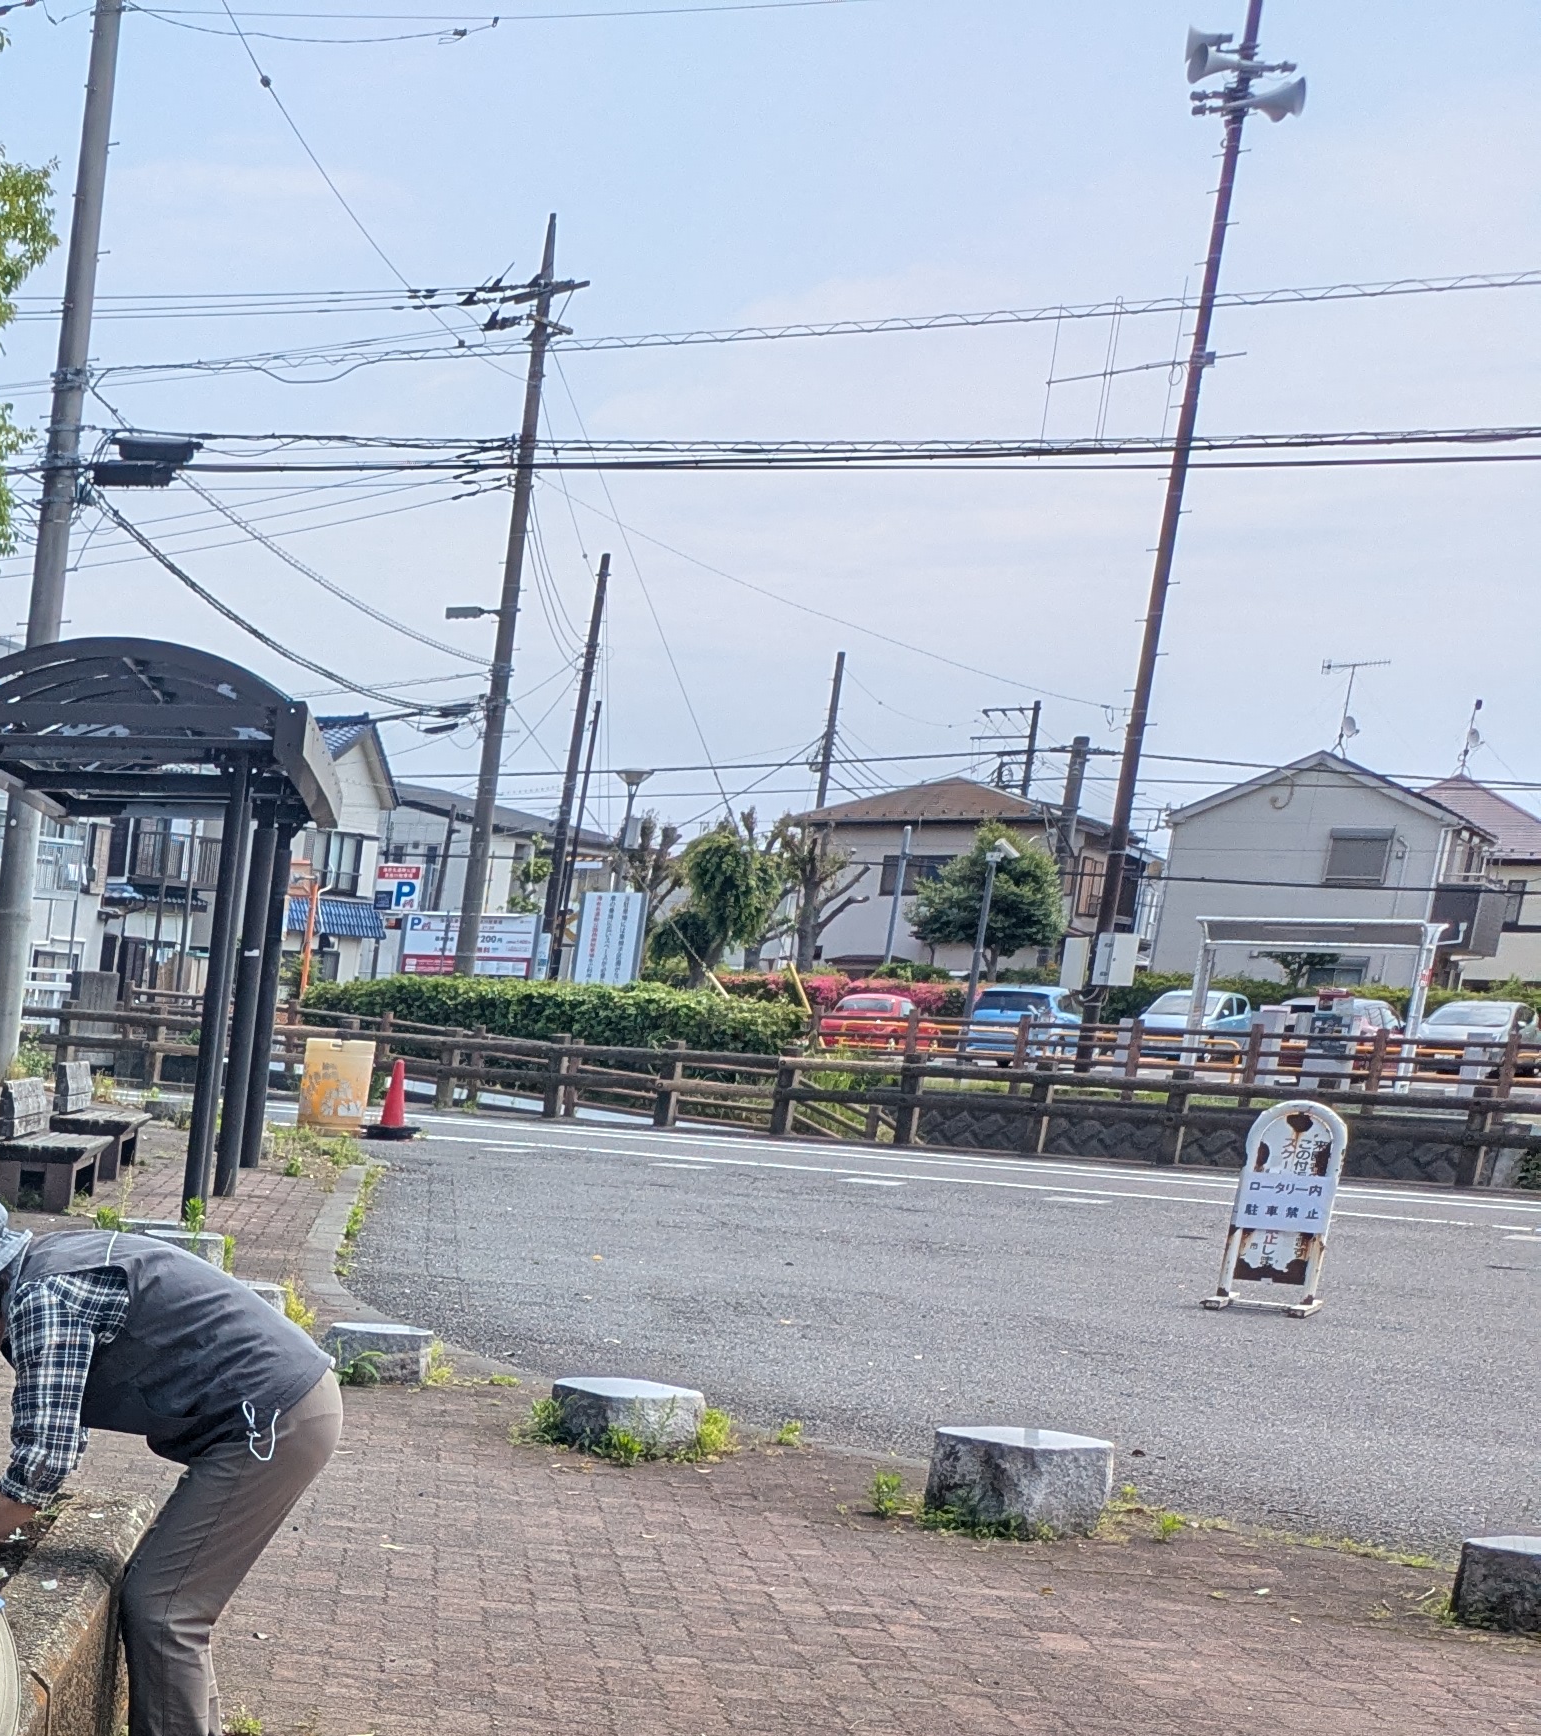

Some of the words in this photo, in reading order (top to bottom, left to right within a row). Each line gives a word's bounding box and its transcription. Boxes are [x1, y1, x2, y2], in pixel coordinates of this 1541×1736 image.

[394, 881, 416, 907] P
[1279, 1138, 1296, 1175] スケー
[1249, 1181, 1323, 1197] ロータリー内
[1244, 1203, 1319, 1220] 駐車禁止
